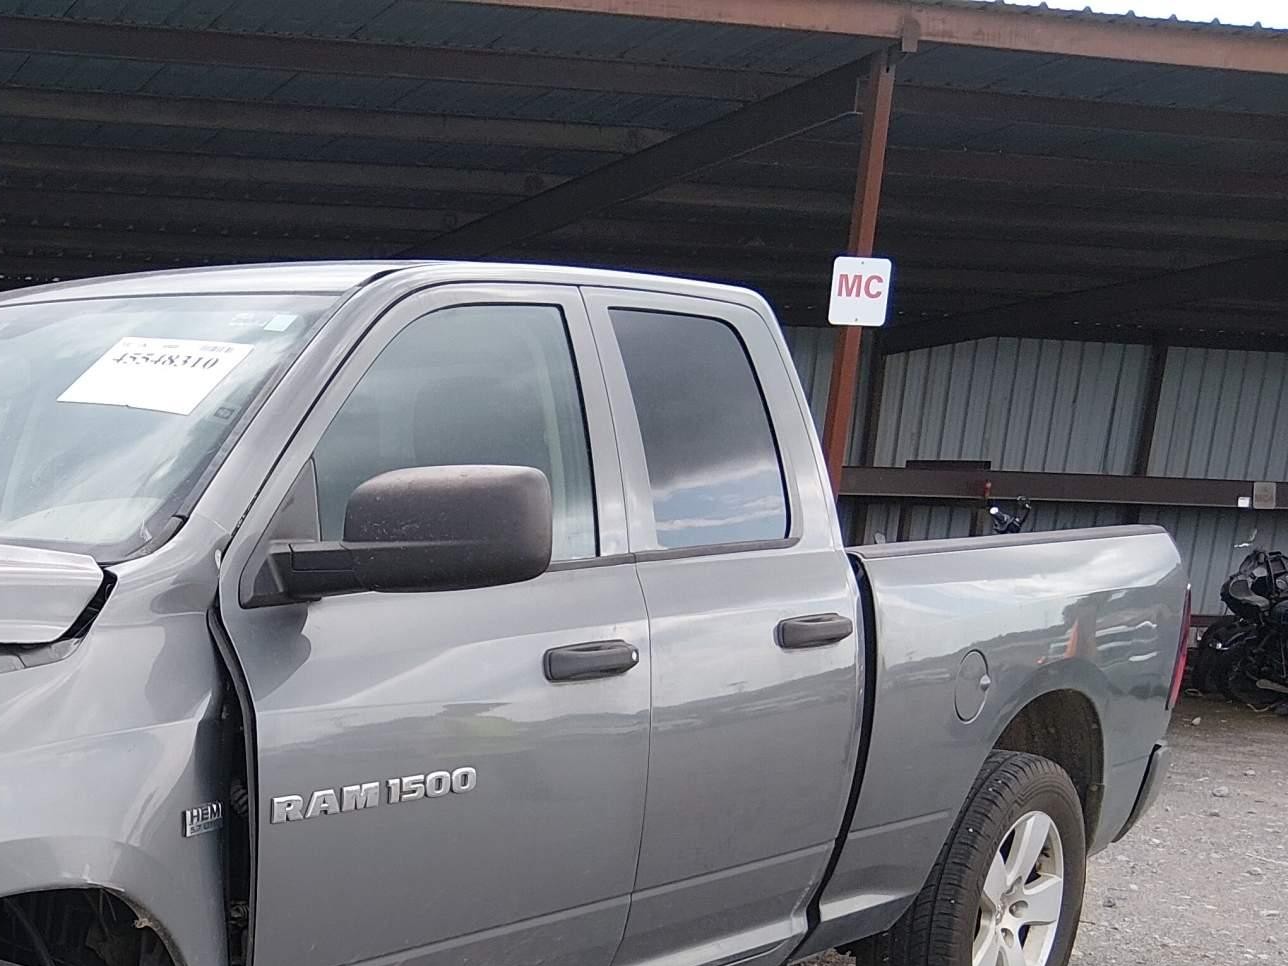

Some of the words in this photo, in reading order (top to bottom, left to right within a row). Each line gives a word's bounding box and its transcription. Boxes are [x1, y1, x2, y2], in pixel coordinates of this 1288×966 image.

[837, 273, 883, 299] MC
[112, 352, 219, 369] 45548310
[270, 780, 380, 825] RAM
[386, 766, 478, 805] 1500
